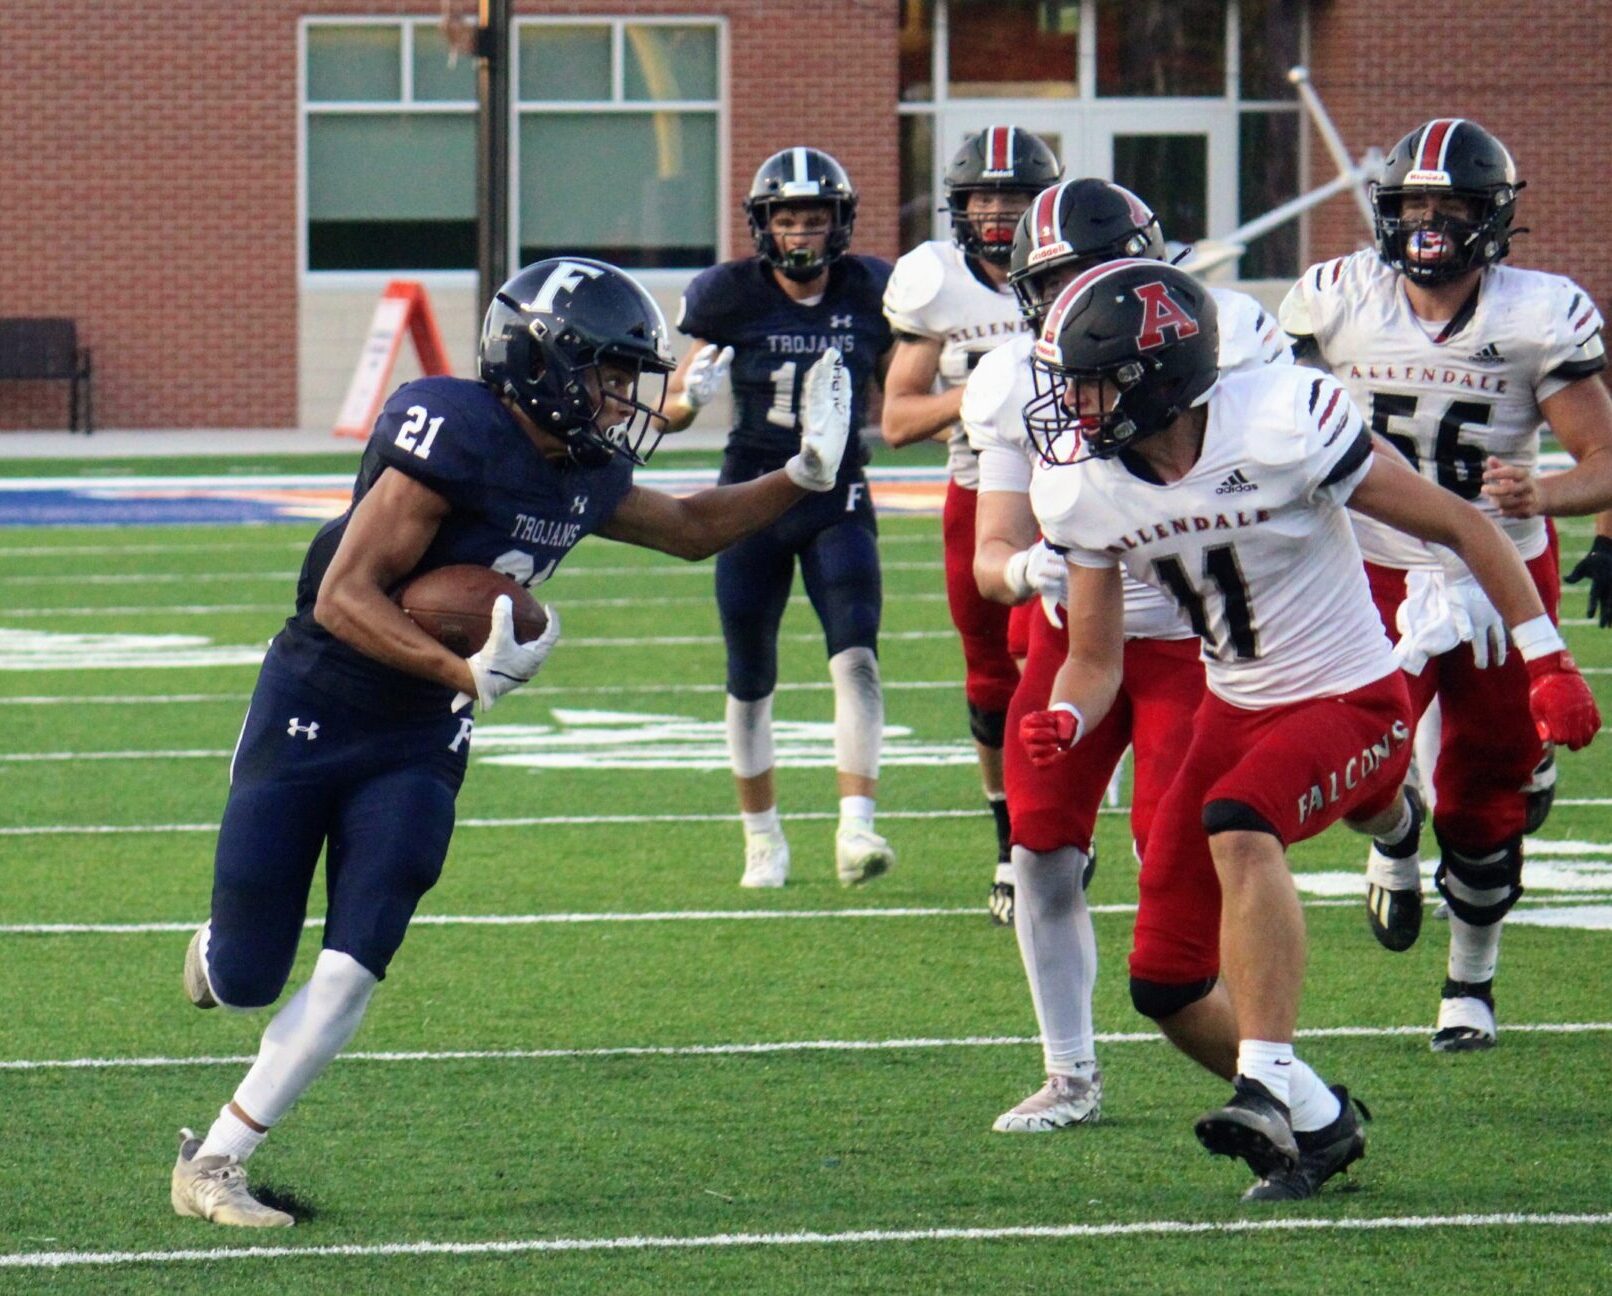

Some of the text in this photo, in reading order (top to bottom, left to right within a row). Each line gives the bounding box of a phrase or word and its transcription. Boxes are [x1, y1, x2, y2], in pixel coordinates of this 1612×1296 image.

[529, 261, 604, 313] F
[1134, 281, 1199, 350] A
[767, 335, 855, 353] TROJANS
[1351, 365, 1507, 393] ALLENDALE
[394, 405, 445, 460] 21
[1369, 392, 1492, 500] 56
[845, 483, 864, 511] F
[1215, 481, 1258, 495] adidas
[511, 513, 580, 548] TROJANS
[1298, 720, 1409, 824] FALCONS
